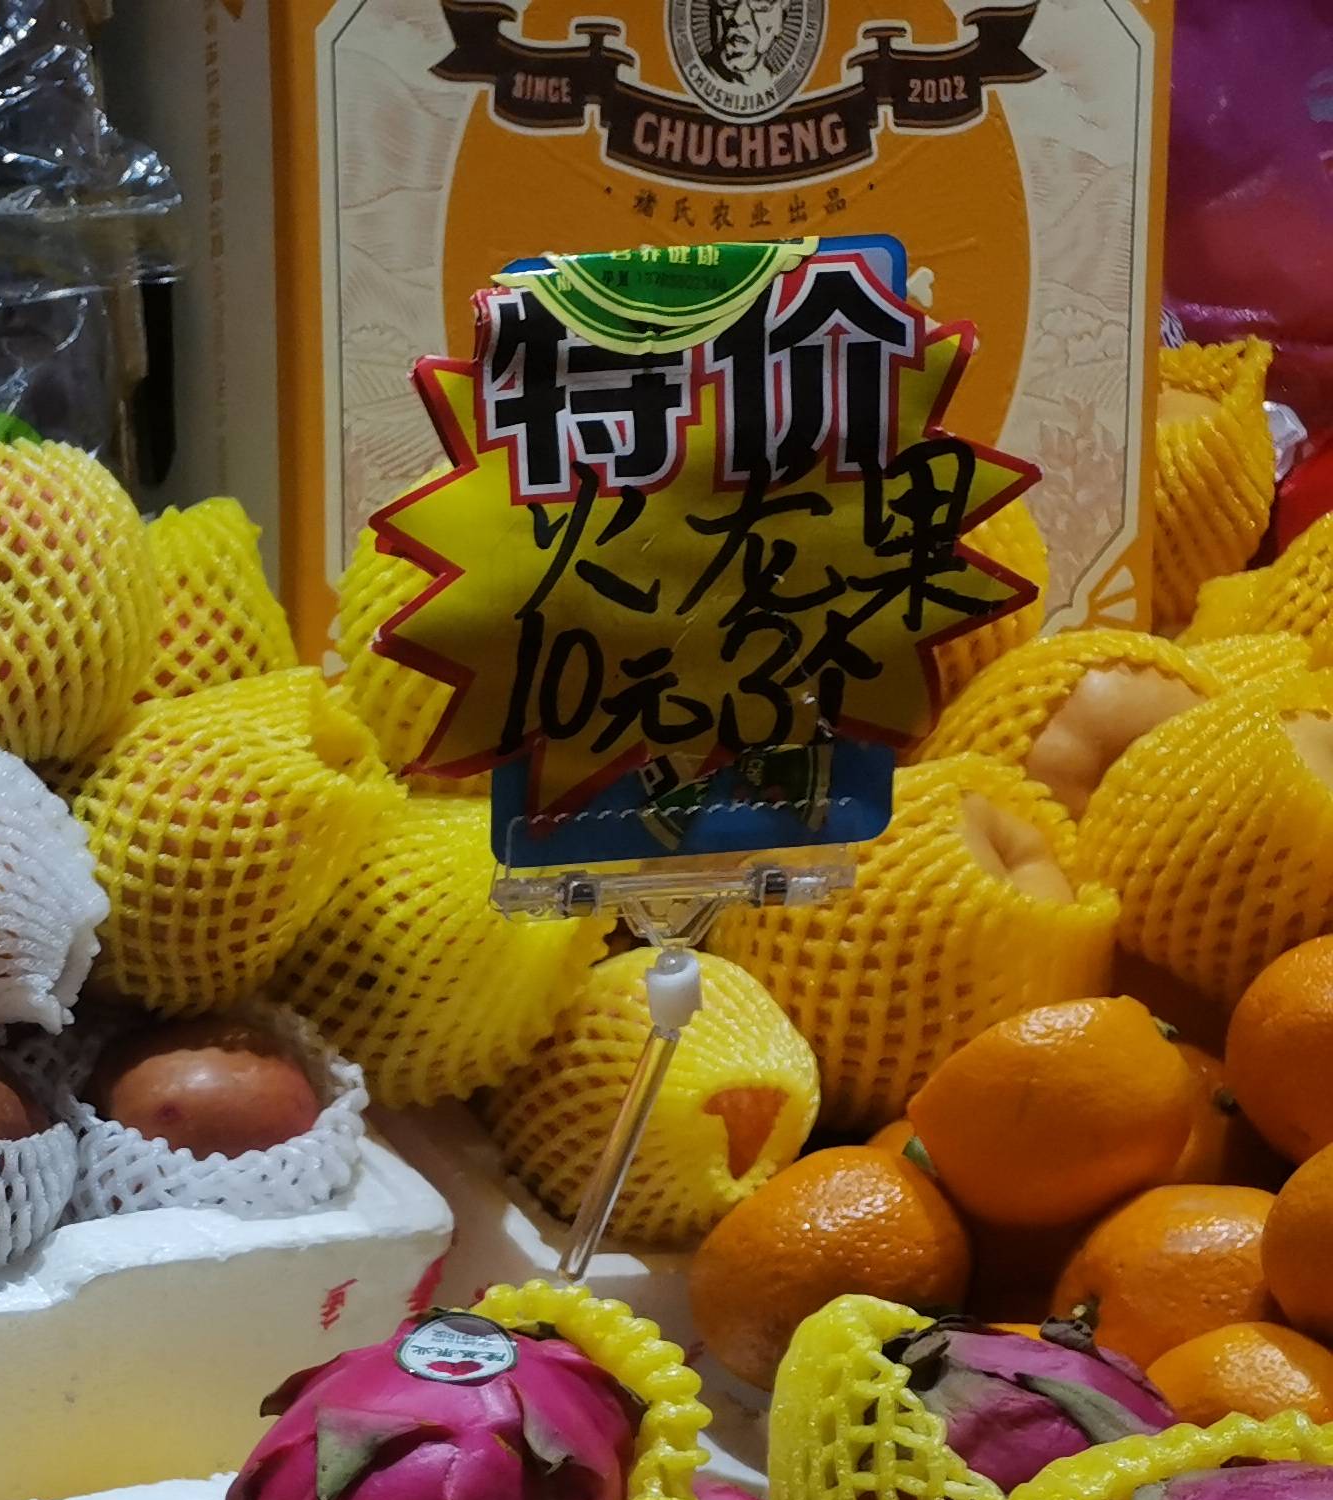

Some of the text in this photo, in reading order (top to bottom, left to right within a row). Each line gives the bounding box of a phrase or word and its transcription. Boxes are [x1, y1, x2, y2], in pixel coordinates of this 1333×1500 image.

[511, 72, 970, 105] SINCE 2002
[633, 110, 848, 169] CHUCHENG
[487, 264, 914, 494] 特价
[516, 439, 1010, 632] 火龙果
